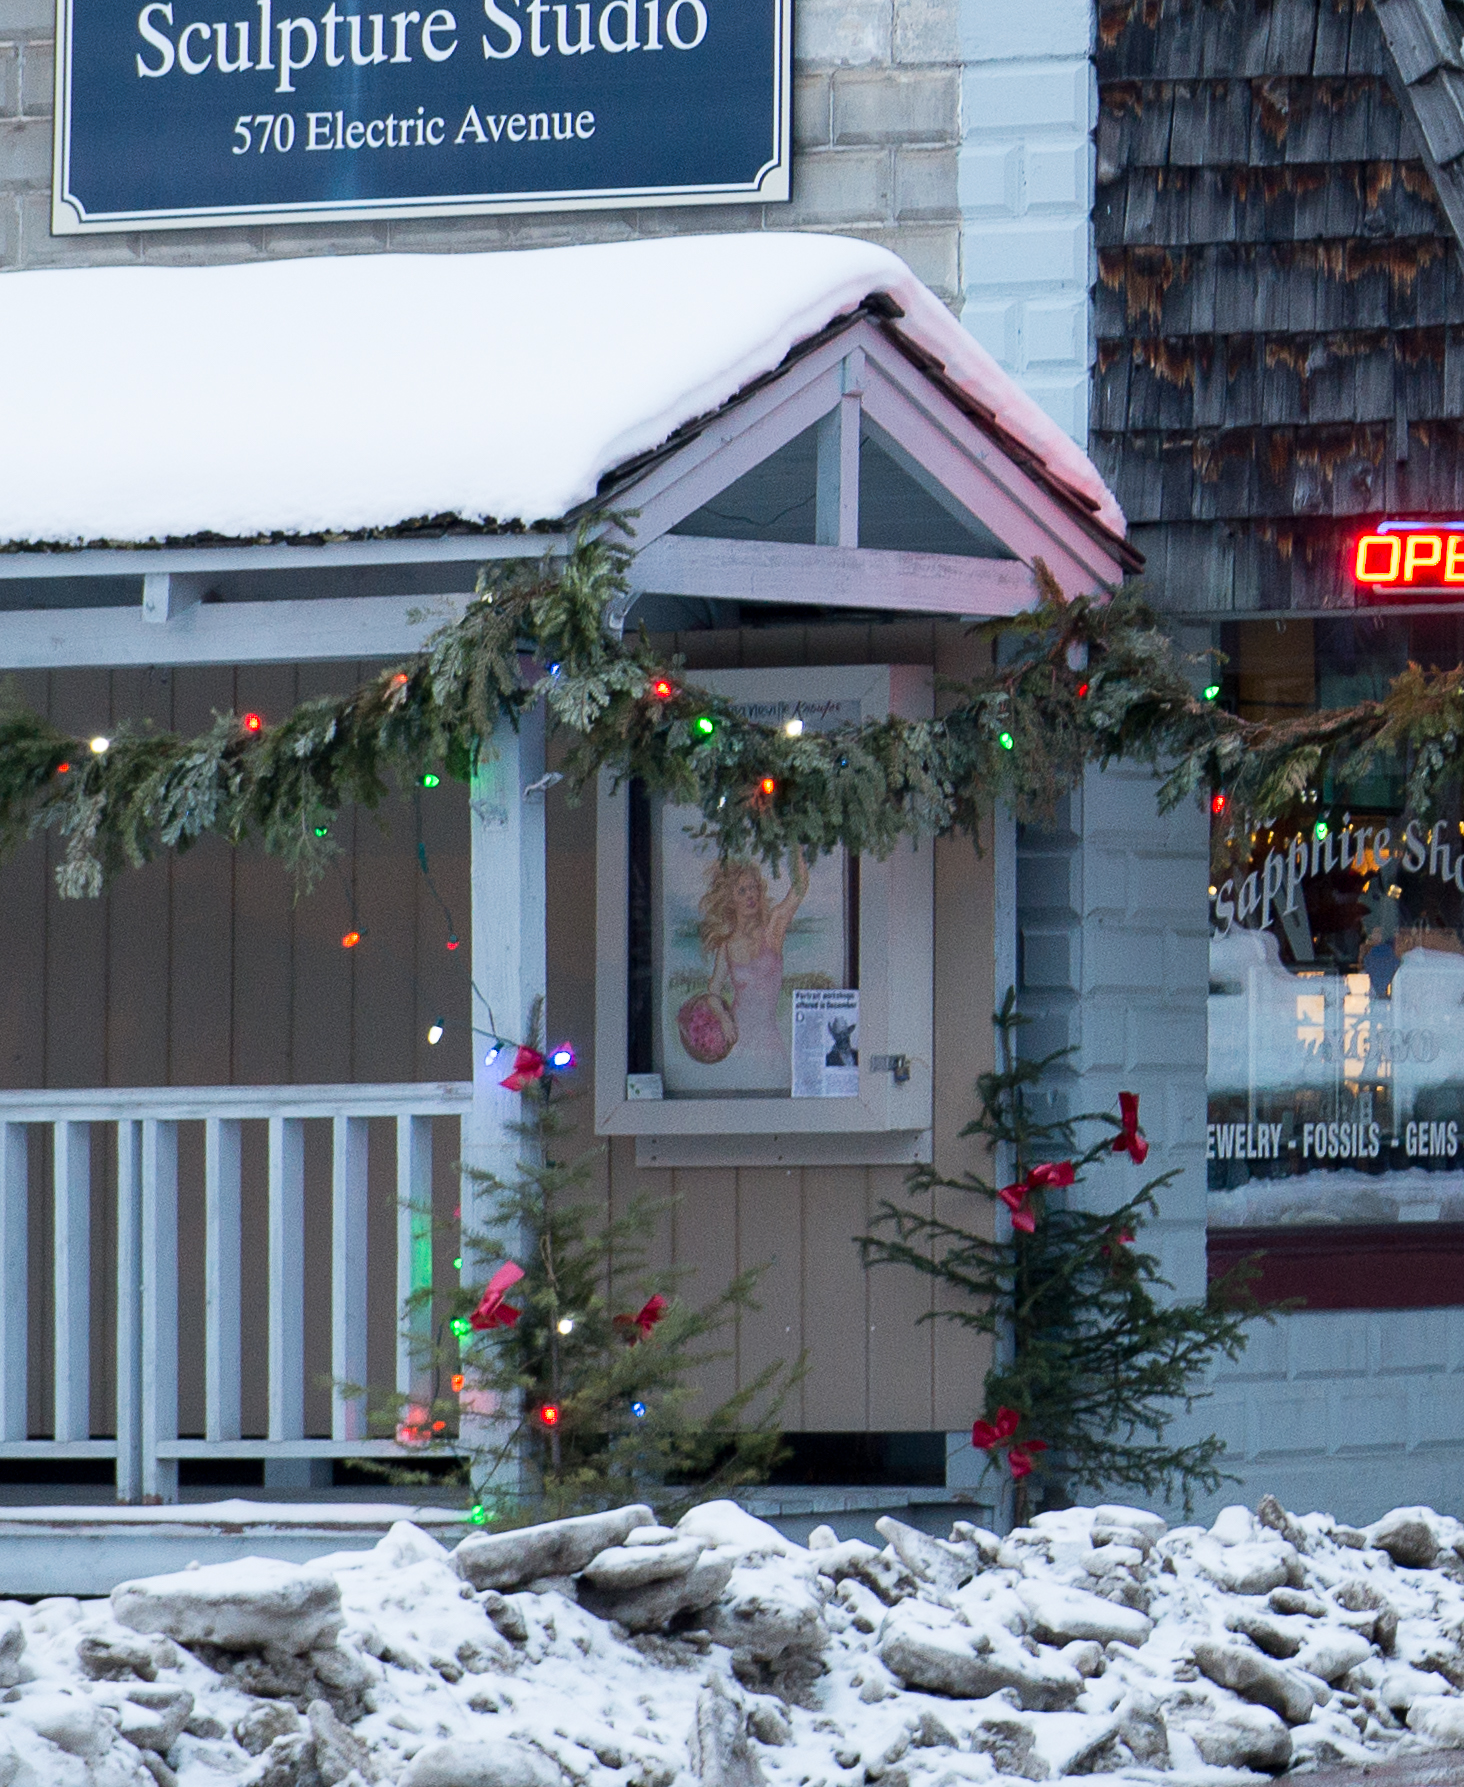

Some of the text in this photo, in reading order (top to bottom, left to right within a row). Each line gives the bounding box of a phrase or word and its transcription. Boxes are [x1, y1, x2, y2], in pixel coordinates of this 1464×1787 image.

[231, 104, 597, 156] 570 Electric Avenue
[1213, 811, 1393, 943] Sapphire
[1206, 1123, 1282, 1159] EWELRY
[1303, 1121, 1380, 1159] FOSSILS
[1405, 1120, 1458, 1157] GEMS
